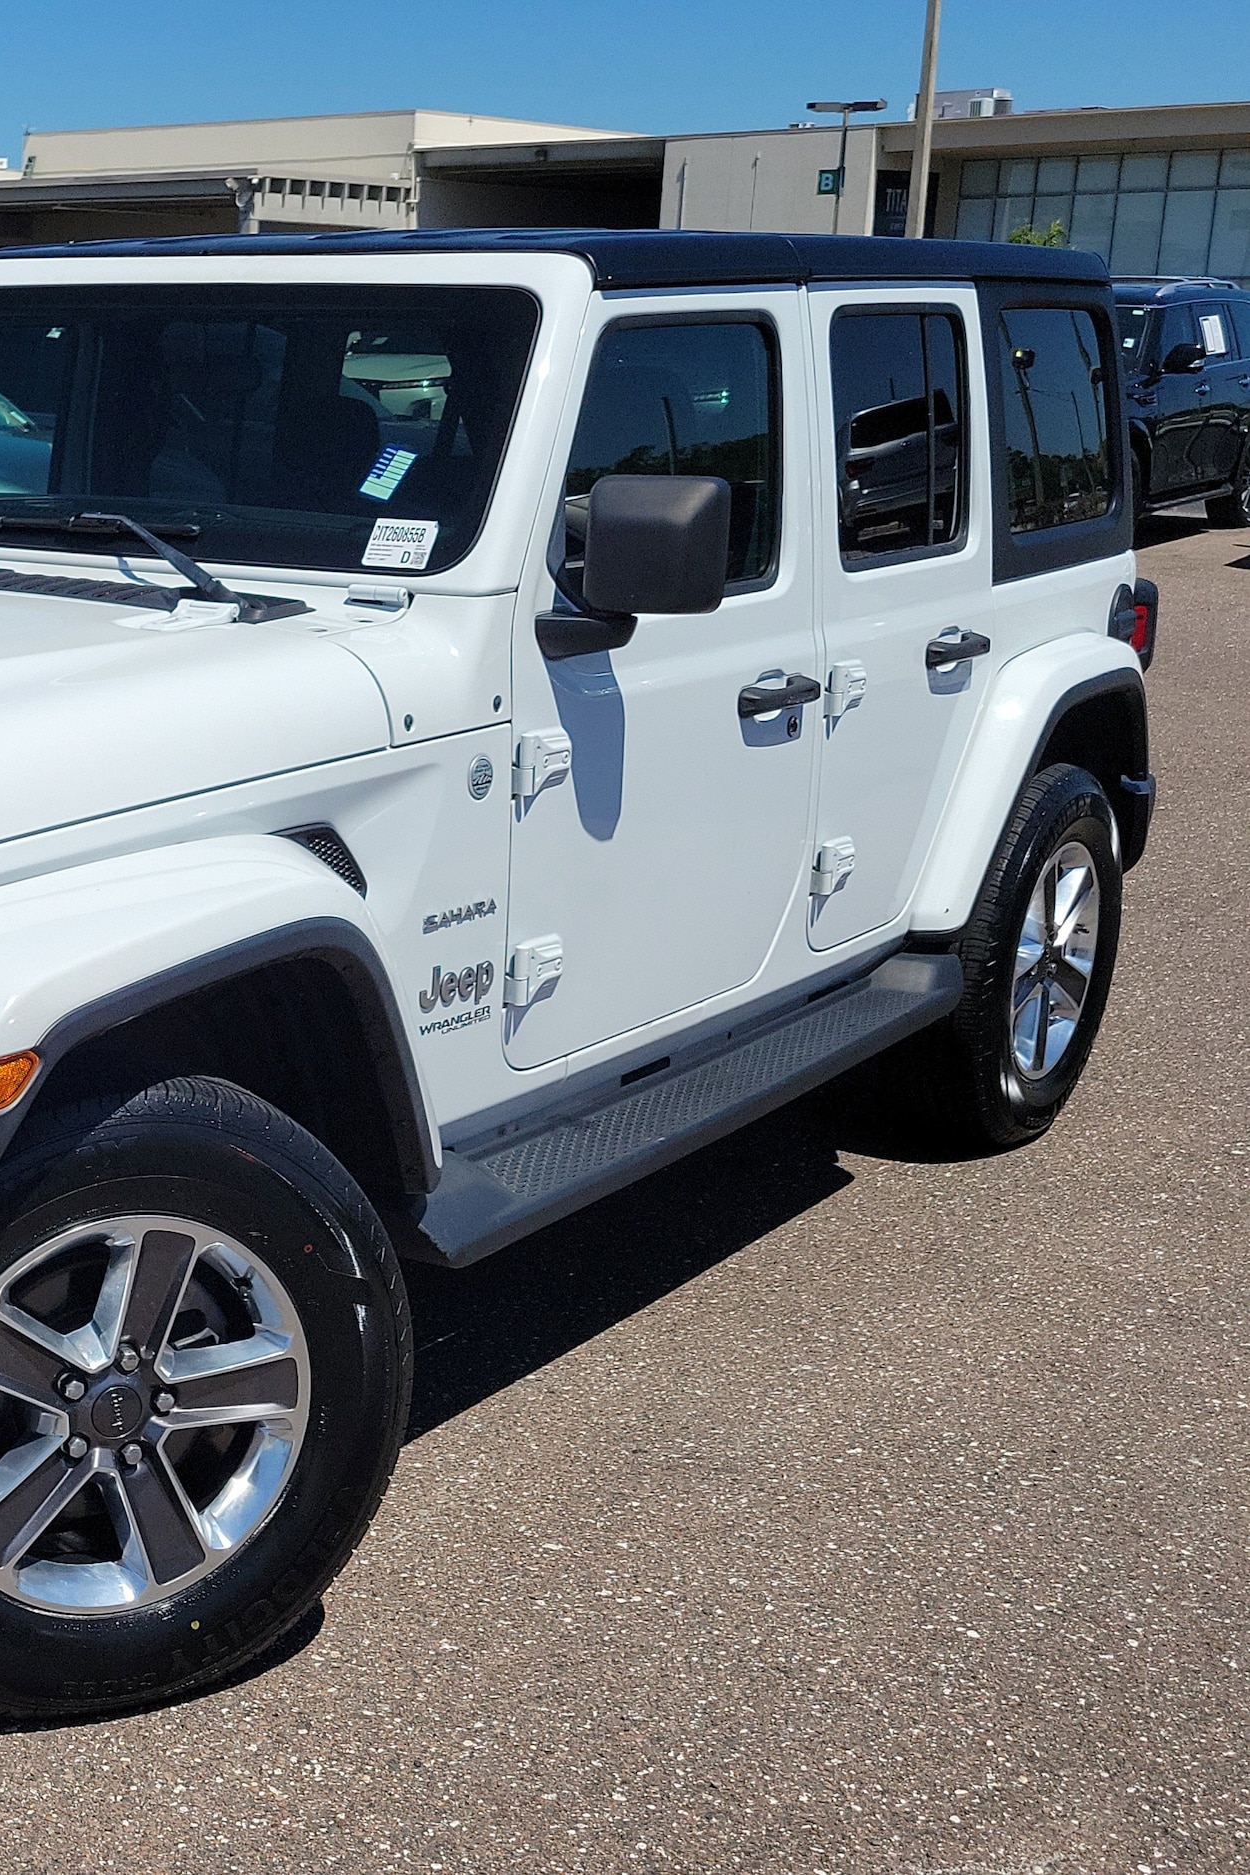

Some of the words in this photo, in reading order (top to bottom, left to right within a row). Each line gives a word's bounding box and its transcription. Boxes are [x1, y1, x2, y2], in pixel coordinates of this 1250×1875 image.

[820, 173, 834, 191] B
[886, 188, 907, 212] TITA
[400, 551, 411, 564] D
[423, 899, 497, 931] SAHARA
[419, 961, 494, 1013] Jeep
[419, 1006, 491, 1035] WRANGLER
